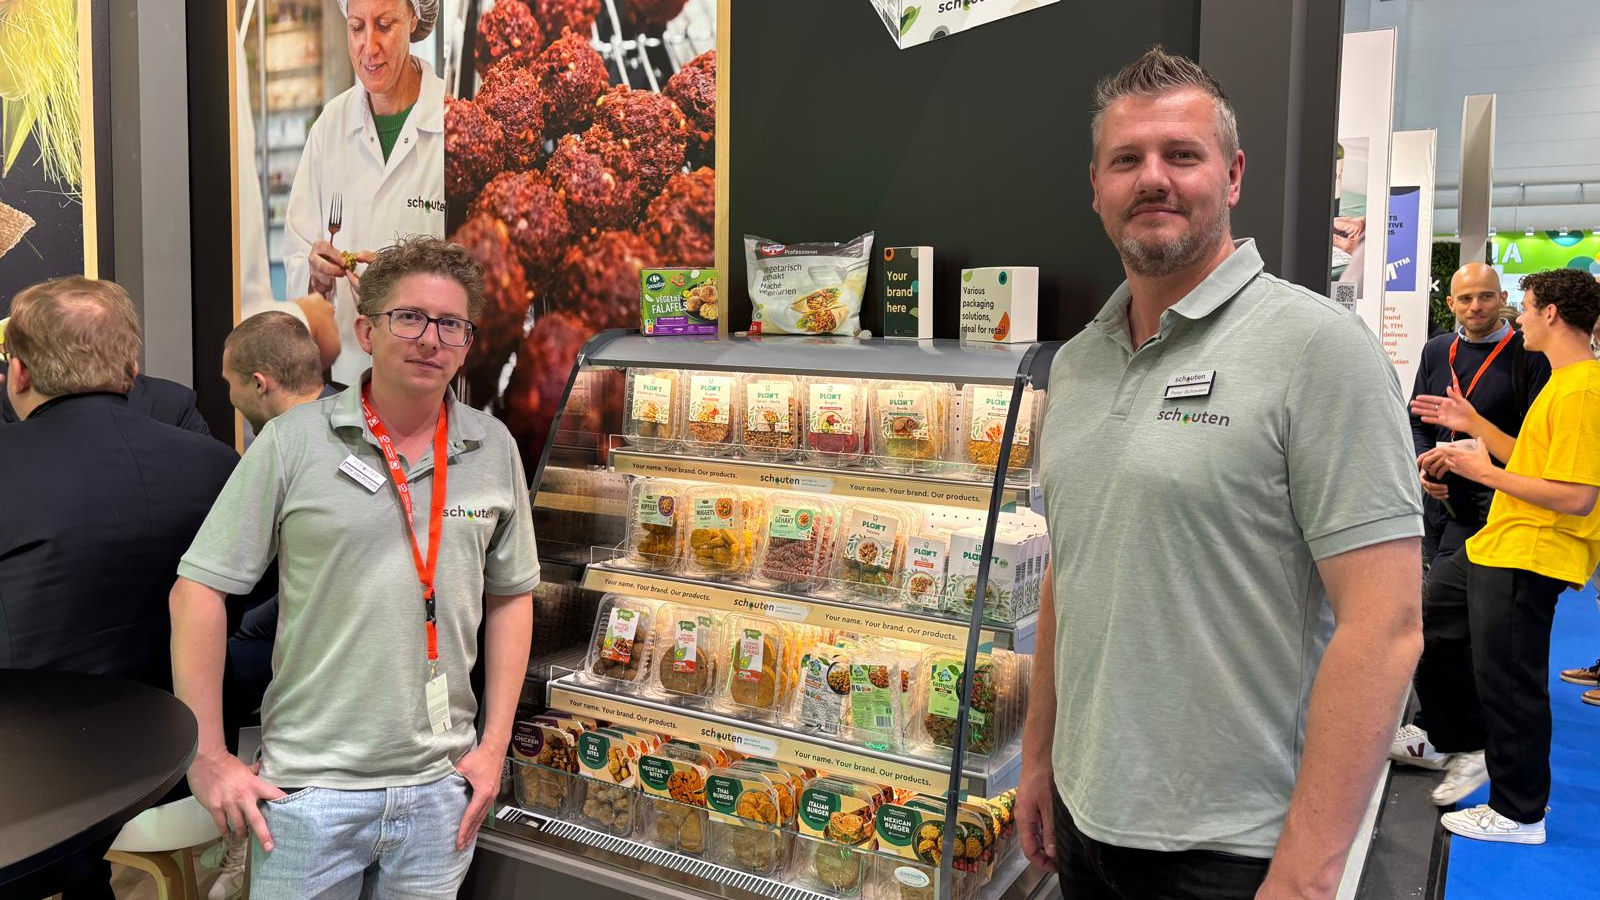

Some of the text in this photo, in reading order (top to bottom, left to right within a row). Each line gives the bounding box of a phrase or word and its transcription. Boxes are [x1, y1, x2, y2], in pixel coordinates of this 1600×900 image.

[887, 271, 908, 282] Your
[887, 286, 913, 297] brand
[963, 287, 985, 295] Various
[652, 301, 688, 314] FALAFELS
[887, 302, 907, 313] here
[962, 299, 995, 310] packaging
[962, 312, 991, 323] solutions,
[961, 325, 1006, 335] ideal for retail
[1175, 373, 1206, 383] schouten
[1157, 407, 1231, 427] schouten
[678, 467, 696, 475] brand.
[710, 470, 738, 479] products.
[760, 474, 800, 485] schouten
[850, 484, 865, 492] Your
[866, 486, 888, 494] name.
[889, 487, 905, 496] Your
[906, 488, 930, 497] brand.
[947, 492, 981, 503] products.
[442, 505, 494, 521] schouten
[914, 548, 938, 558] PLAN'T
[618, 581, 635, 589] name.
[636, 584, 650, 592] Your
[650, 586, 669, 595] brand.
[670, 589, 682, 597] Our
[682, 591, 711, 601] products.
[734, 598, 775, 611] schouten
[825, 613, 958, 641] Your name. Your brand. Our products.
[584, 703, 601, 712] name.
[602, 706, 615, 715] Your
[616, 709, 636, 720] brand.
[649, 716, 678, 729] products.
[515, 735, 539, 745] CHICKEN
[701, 728, 743, 744] schouten
[587, 750, 600, 758] BITES
[642, 765, 670, 775] VEGETABLE
[795, 750, 932, 787] Your name. Your brand. Our products.
[649, 771, 664, 779] BITES
[713, 792, 734, 801] BURGER
[808, 801, 829, 811] ITALIAN
[807, 807, 829, 818] BURGER
[884, 816, 912, 827] MEXICAN
[885, 822, 910, 834] BURGER
